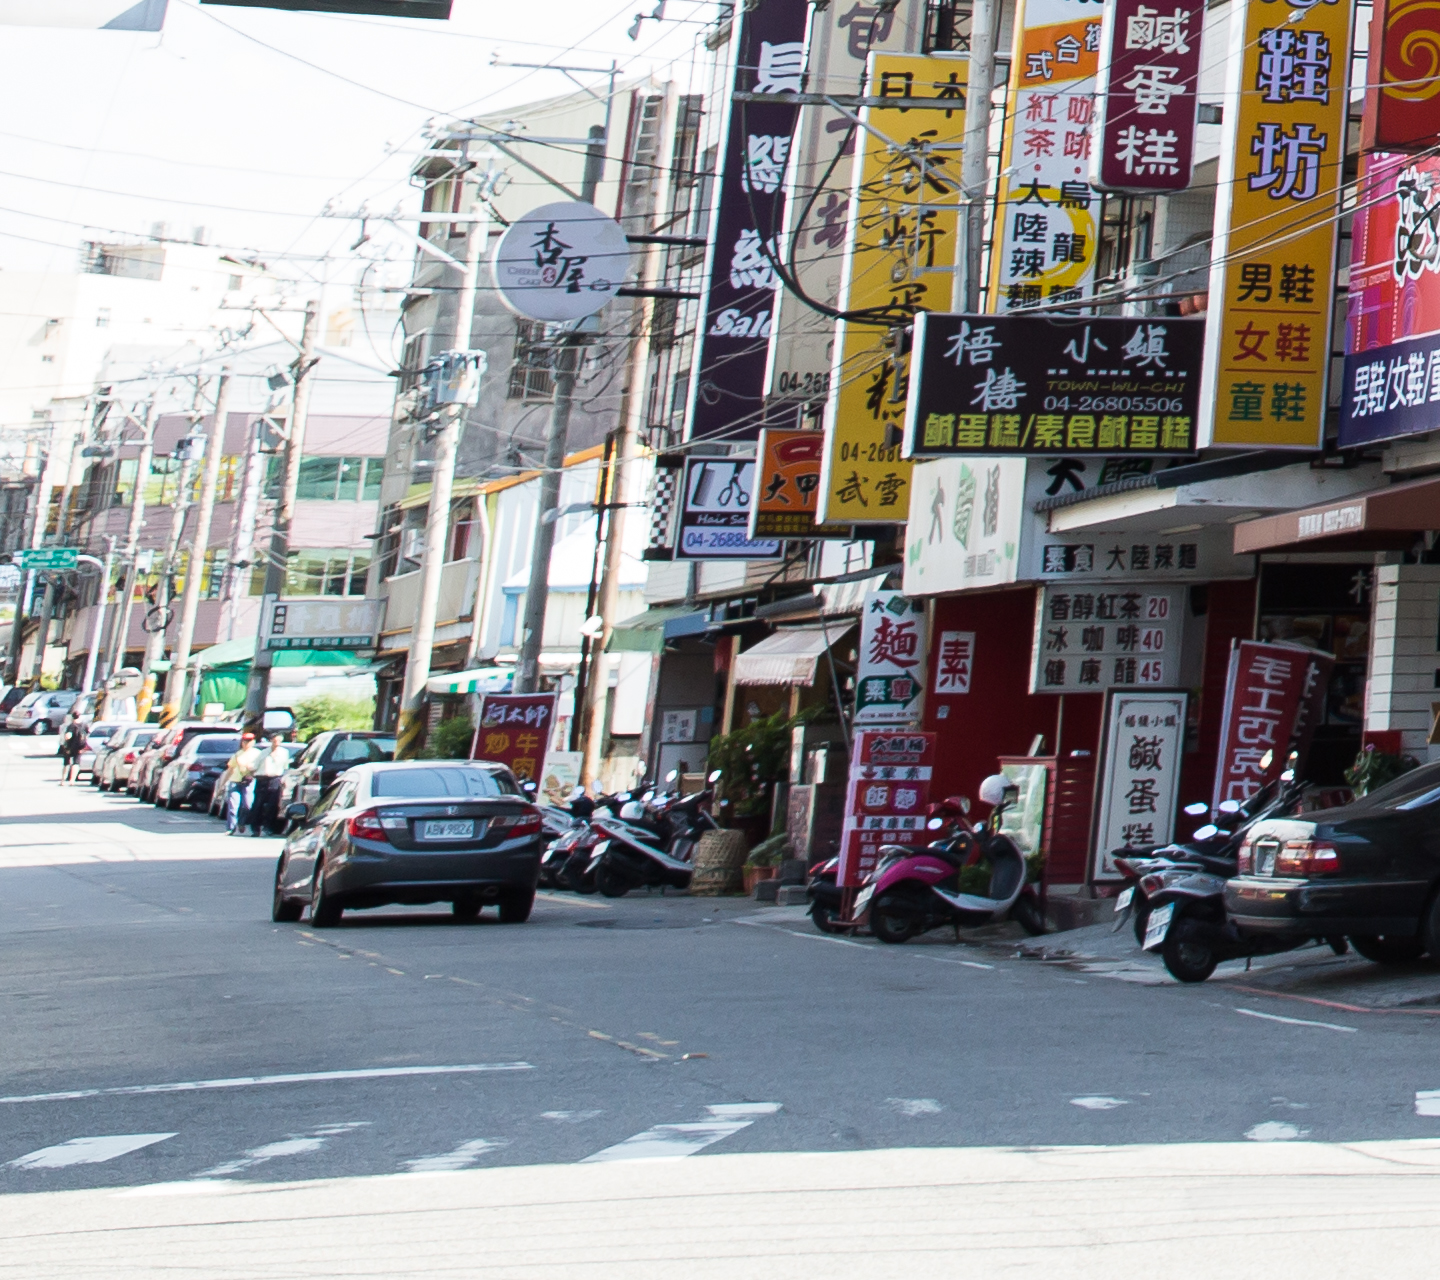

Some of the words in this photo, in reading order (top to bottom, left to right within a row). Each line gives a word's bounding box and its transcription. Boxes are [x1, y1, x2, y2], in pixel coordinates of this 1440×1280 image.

[1114, 3, 1192, 177] 鹹蛋糕
[1236, 263, 1315, 304] 男鞋
[1232, 320, 1311, 363] 女鞋
[1047, 379, 1186, 393] TOWN-WU-CHI
[1228, 381, 1307, 423] 童鞋
[1044, 395, 1184, 413] 04-26805506
[763, 473, 820, 506] 大甲
[1046, 545, 1093, 572] 素食
[1105, 544, 1198, 570] 大陸辣麵
[1050, 592, 1142, 620] 香醇紅茶
[1148, 597, 1169, 619] 20
[868, 616, 921, 669] 麵
[1046, 625, 1139, 653] 冰咖啡
[1142, 630, 1164, 651] 40
[939, 638, 971, 688] 素
[1045, 657, 1137, 686] 健康醋
[1140, 661, 1163, 683] 45
